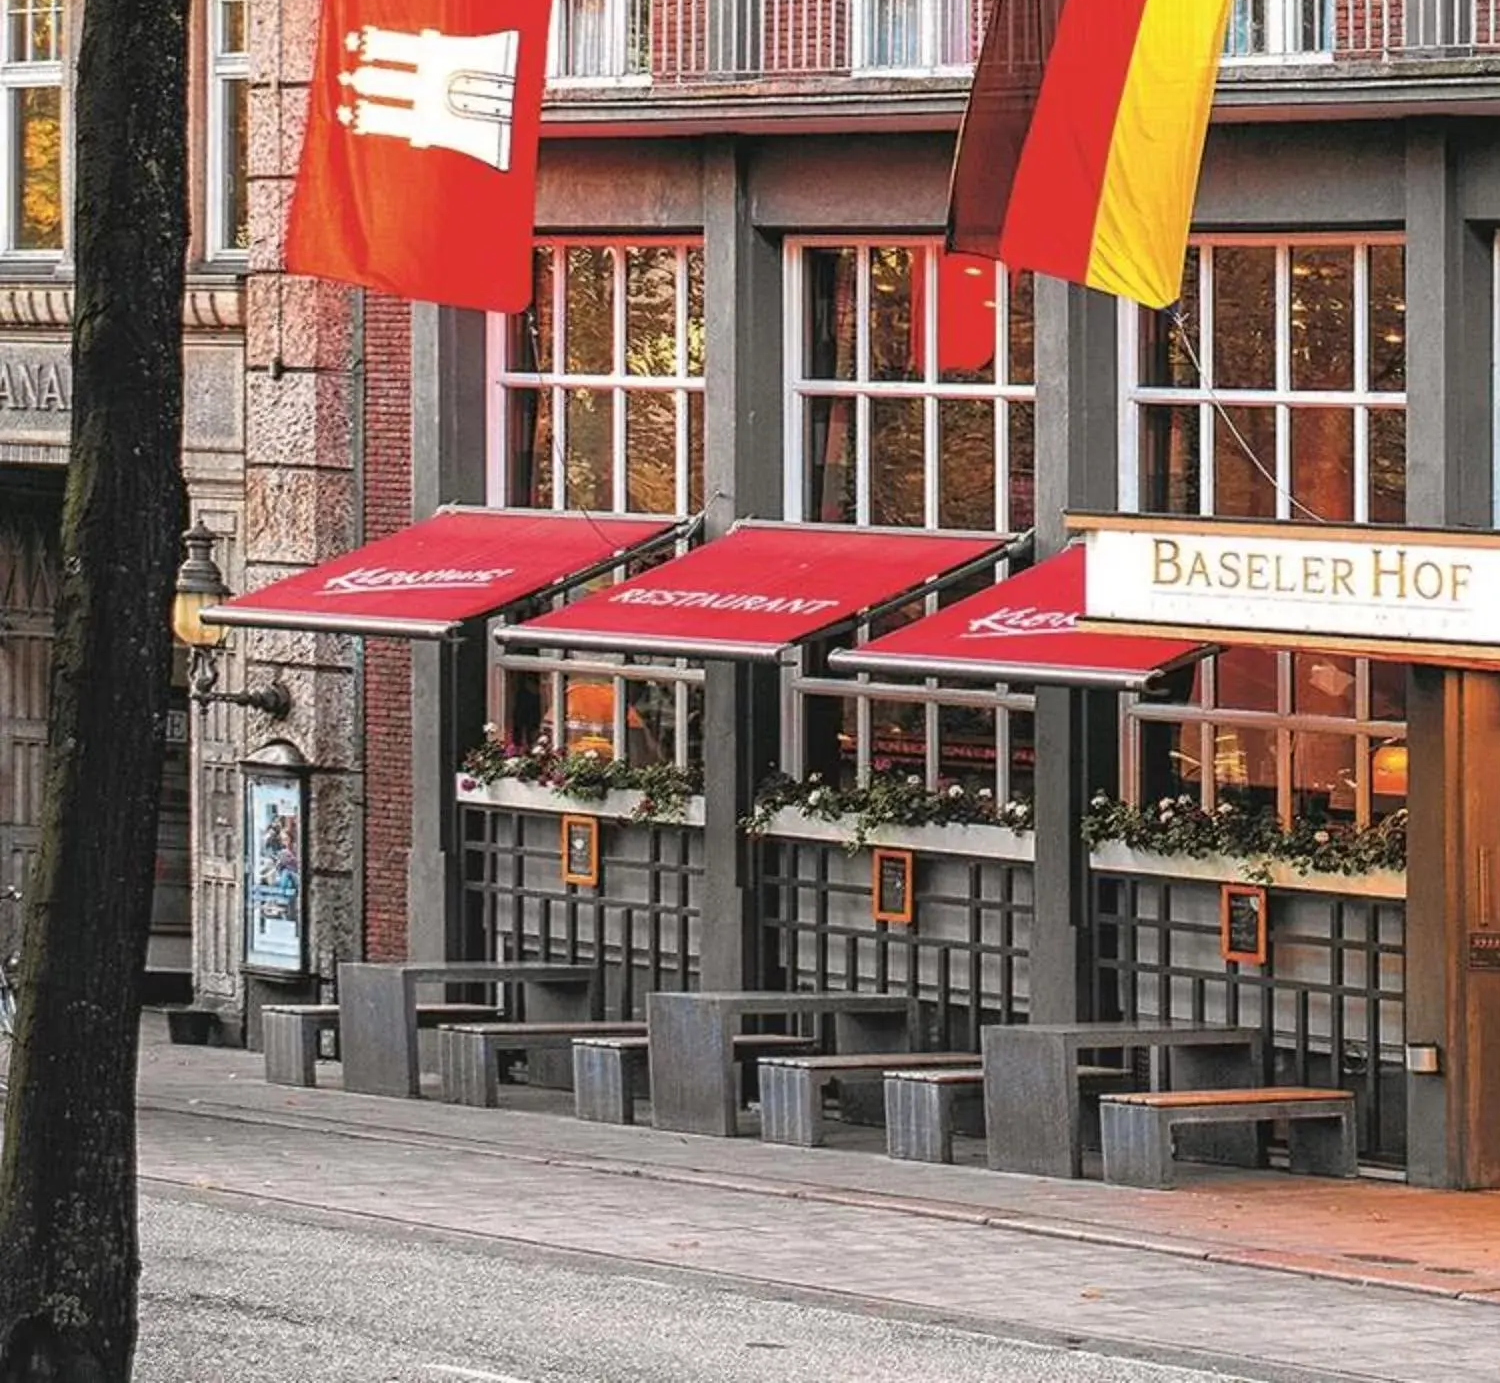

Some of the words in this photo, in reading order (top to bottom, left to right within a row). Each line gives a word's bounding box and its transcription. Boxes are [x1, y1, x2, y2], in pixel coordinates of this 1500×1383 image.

[1152, 537, 1355, 596] BASELER
[1371, 549, 1473, 601] HOF
[608, 588, 840, 615] RESTAURANT
